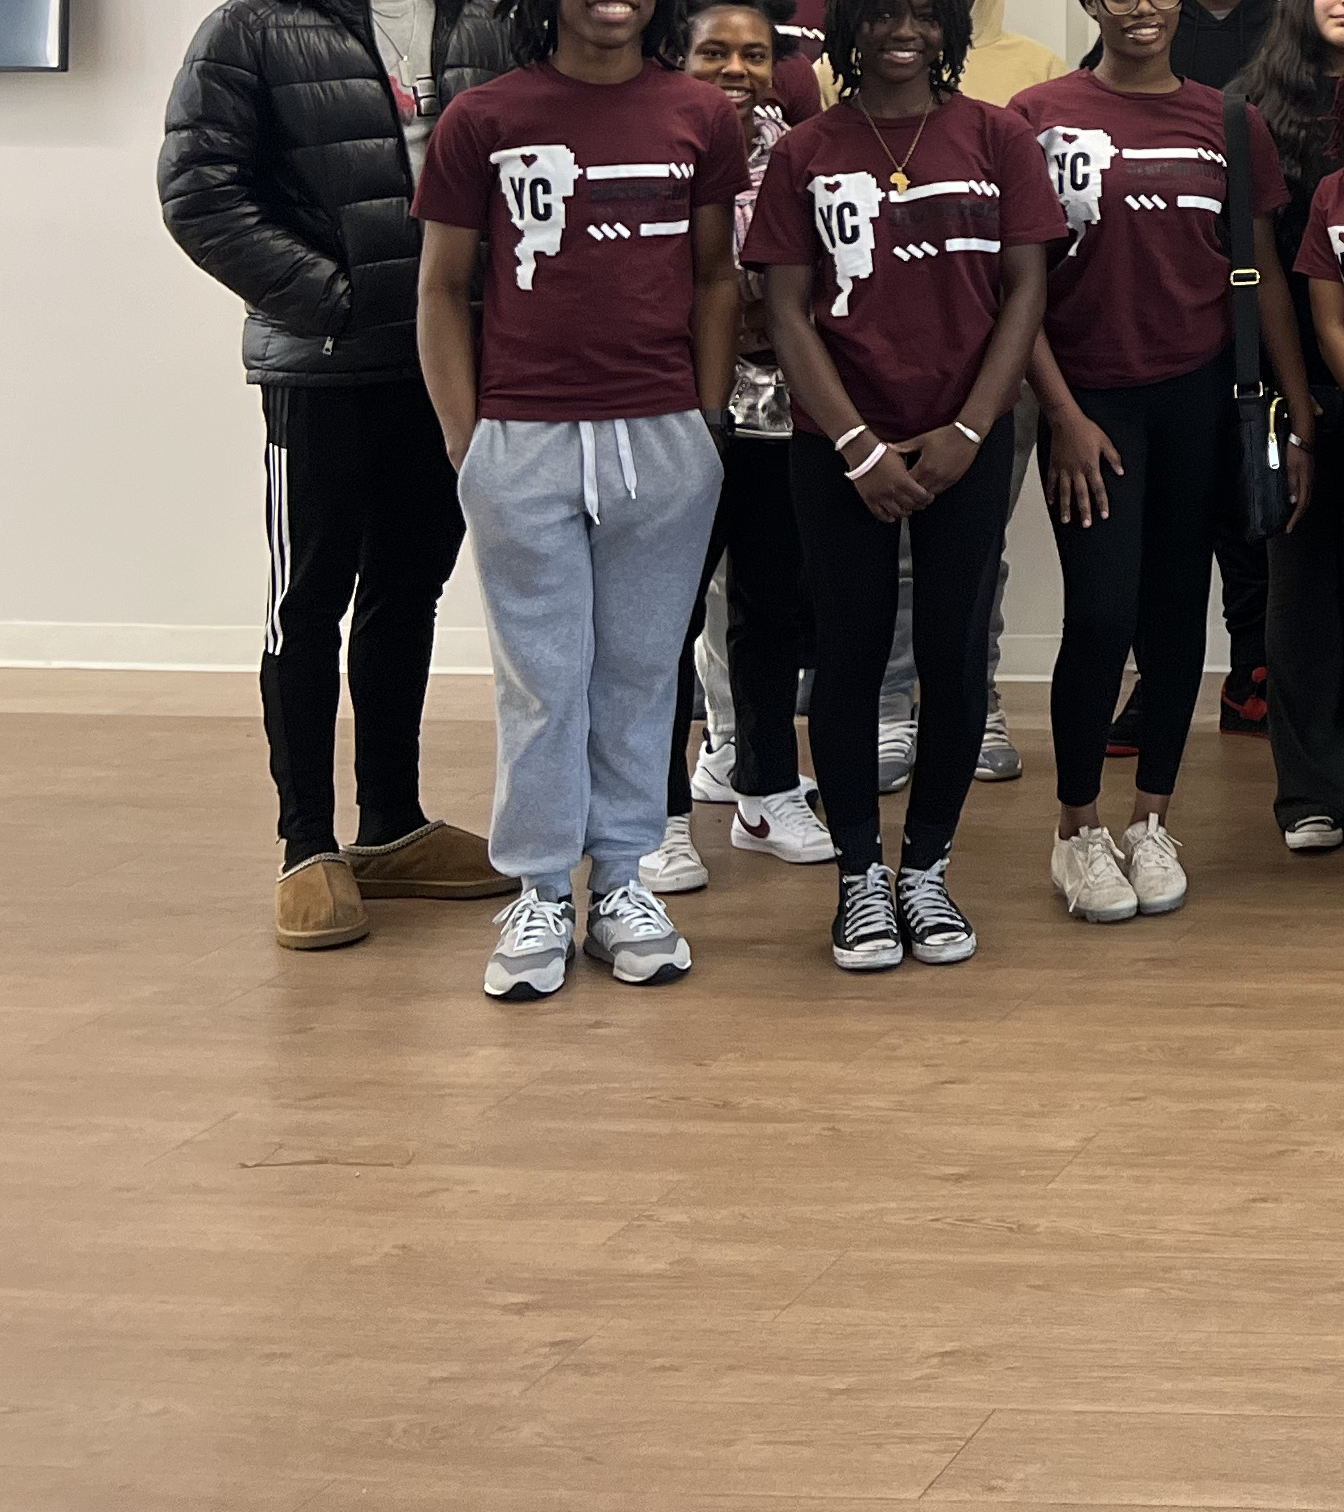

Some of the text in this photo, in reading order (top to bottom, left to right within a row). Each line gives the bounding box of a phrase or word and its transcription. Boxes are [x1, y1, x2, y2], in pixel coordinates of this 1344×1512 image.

[1053, 151, 1091, 195] YC
[509, 176, 553, 222] YC
[818, 201, 861, 249] YC
